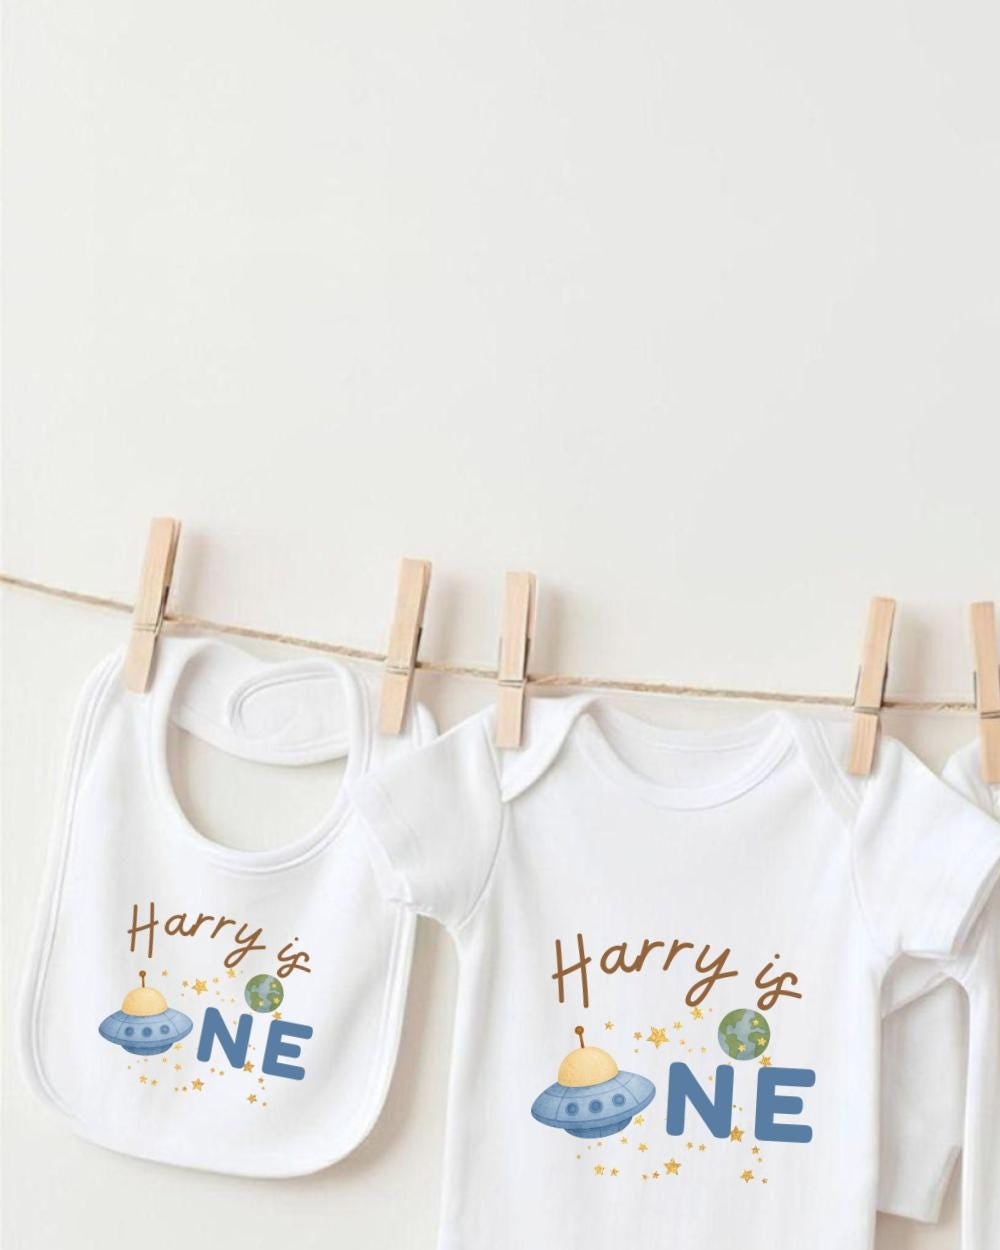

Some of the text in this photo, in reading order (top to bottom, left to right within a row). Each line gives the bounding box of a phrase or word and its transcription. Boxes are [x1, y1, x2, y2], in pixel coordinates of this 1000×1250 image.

[128, 901, 312, 979] Harry is
[553, 933, 802, 1011] Harry is
